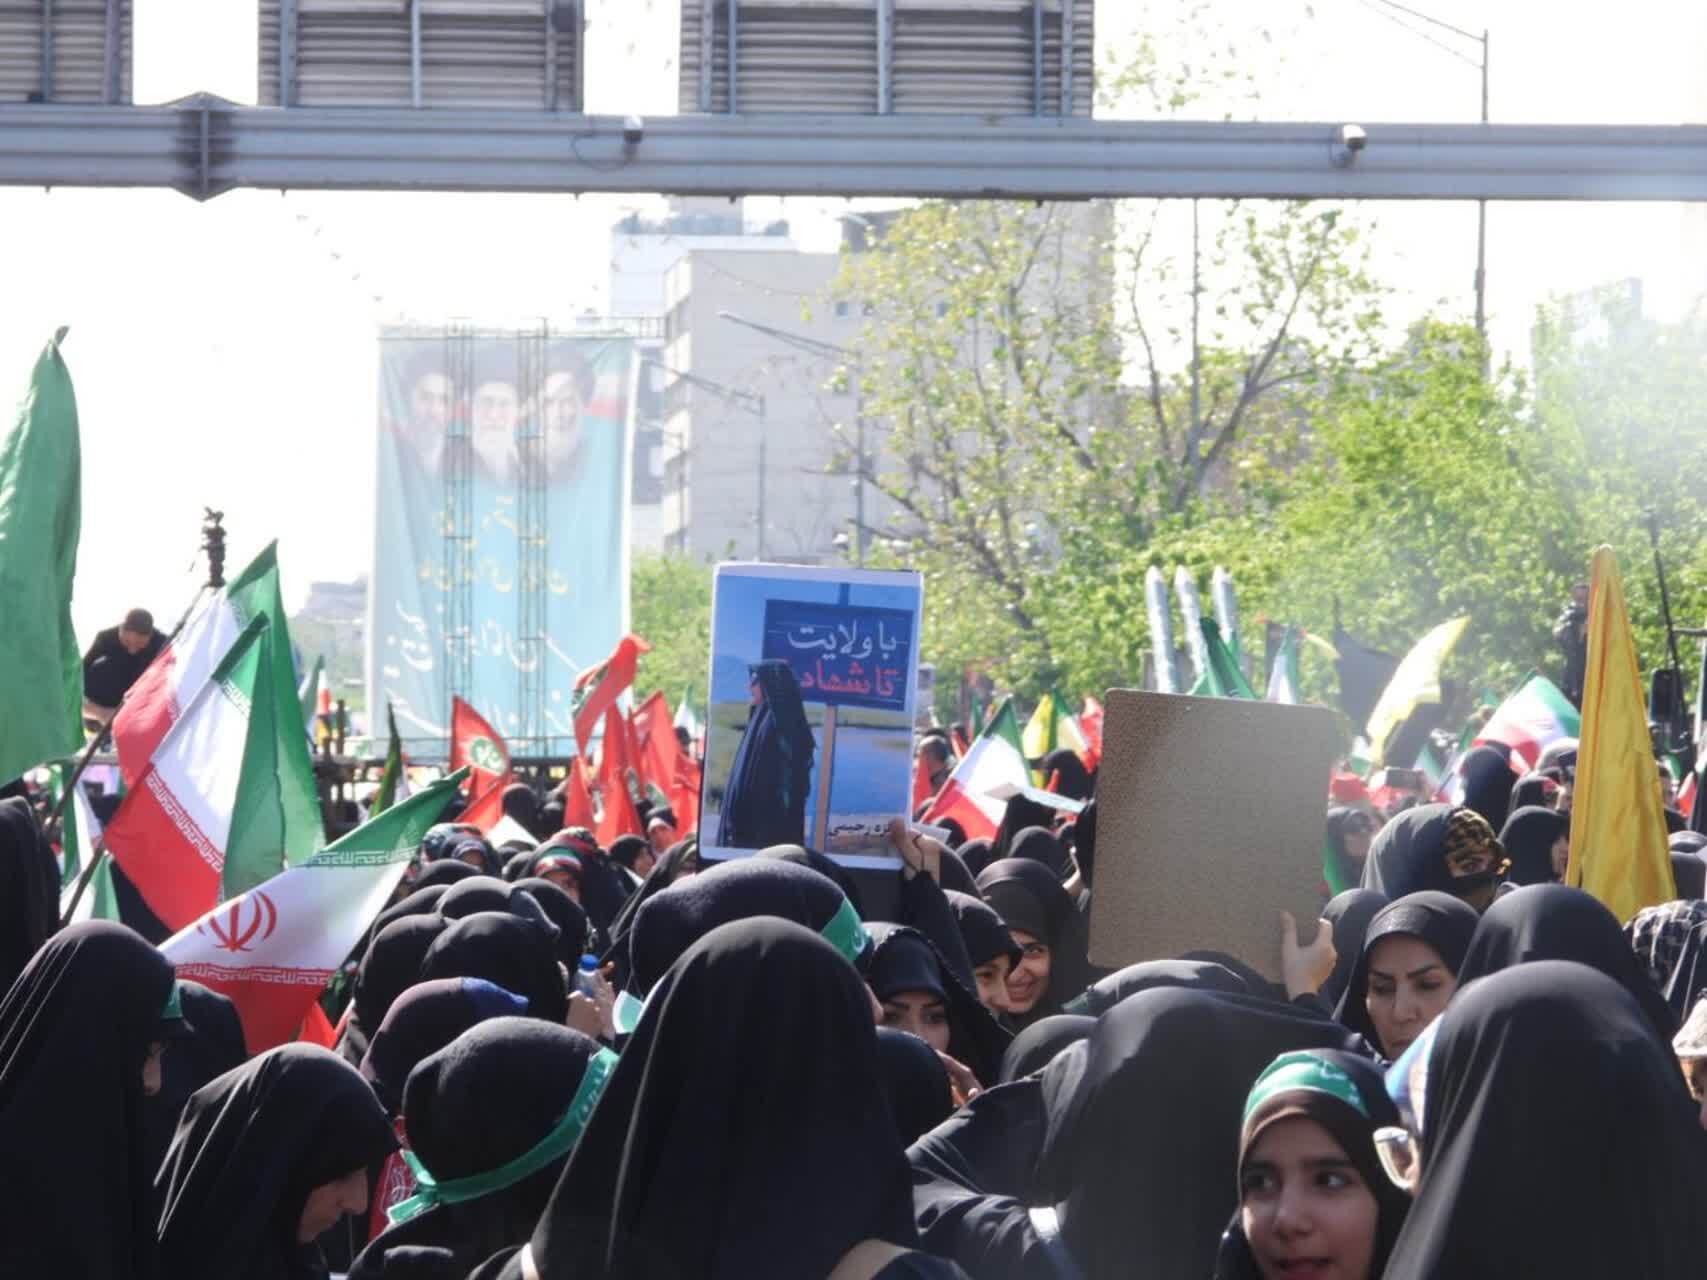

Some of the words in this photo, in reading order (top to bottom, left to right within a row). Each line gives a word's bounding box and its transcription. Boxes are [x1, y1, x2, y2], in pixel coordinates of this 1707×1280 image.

[787, 619, 873, 660] ولایت
[879, 620, 897, 660] با
[800, 658, 870, 695] شهاد
[875, 664, 898, 696] تا
